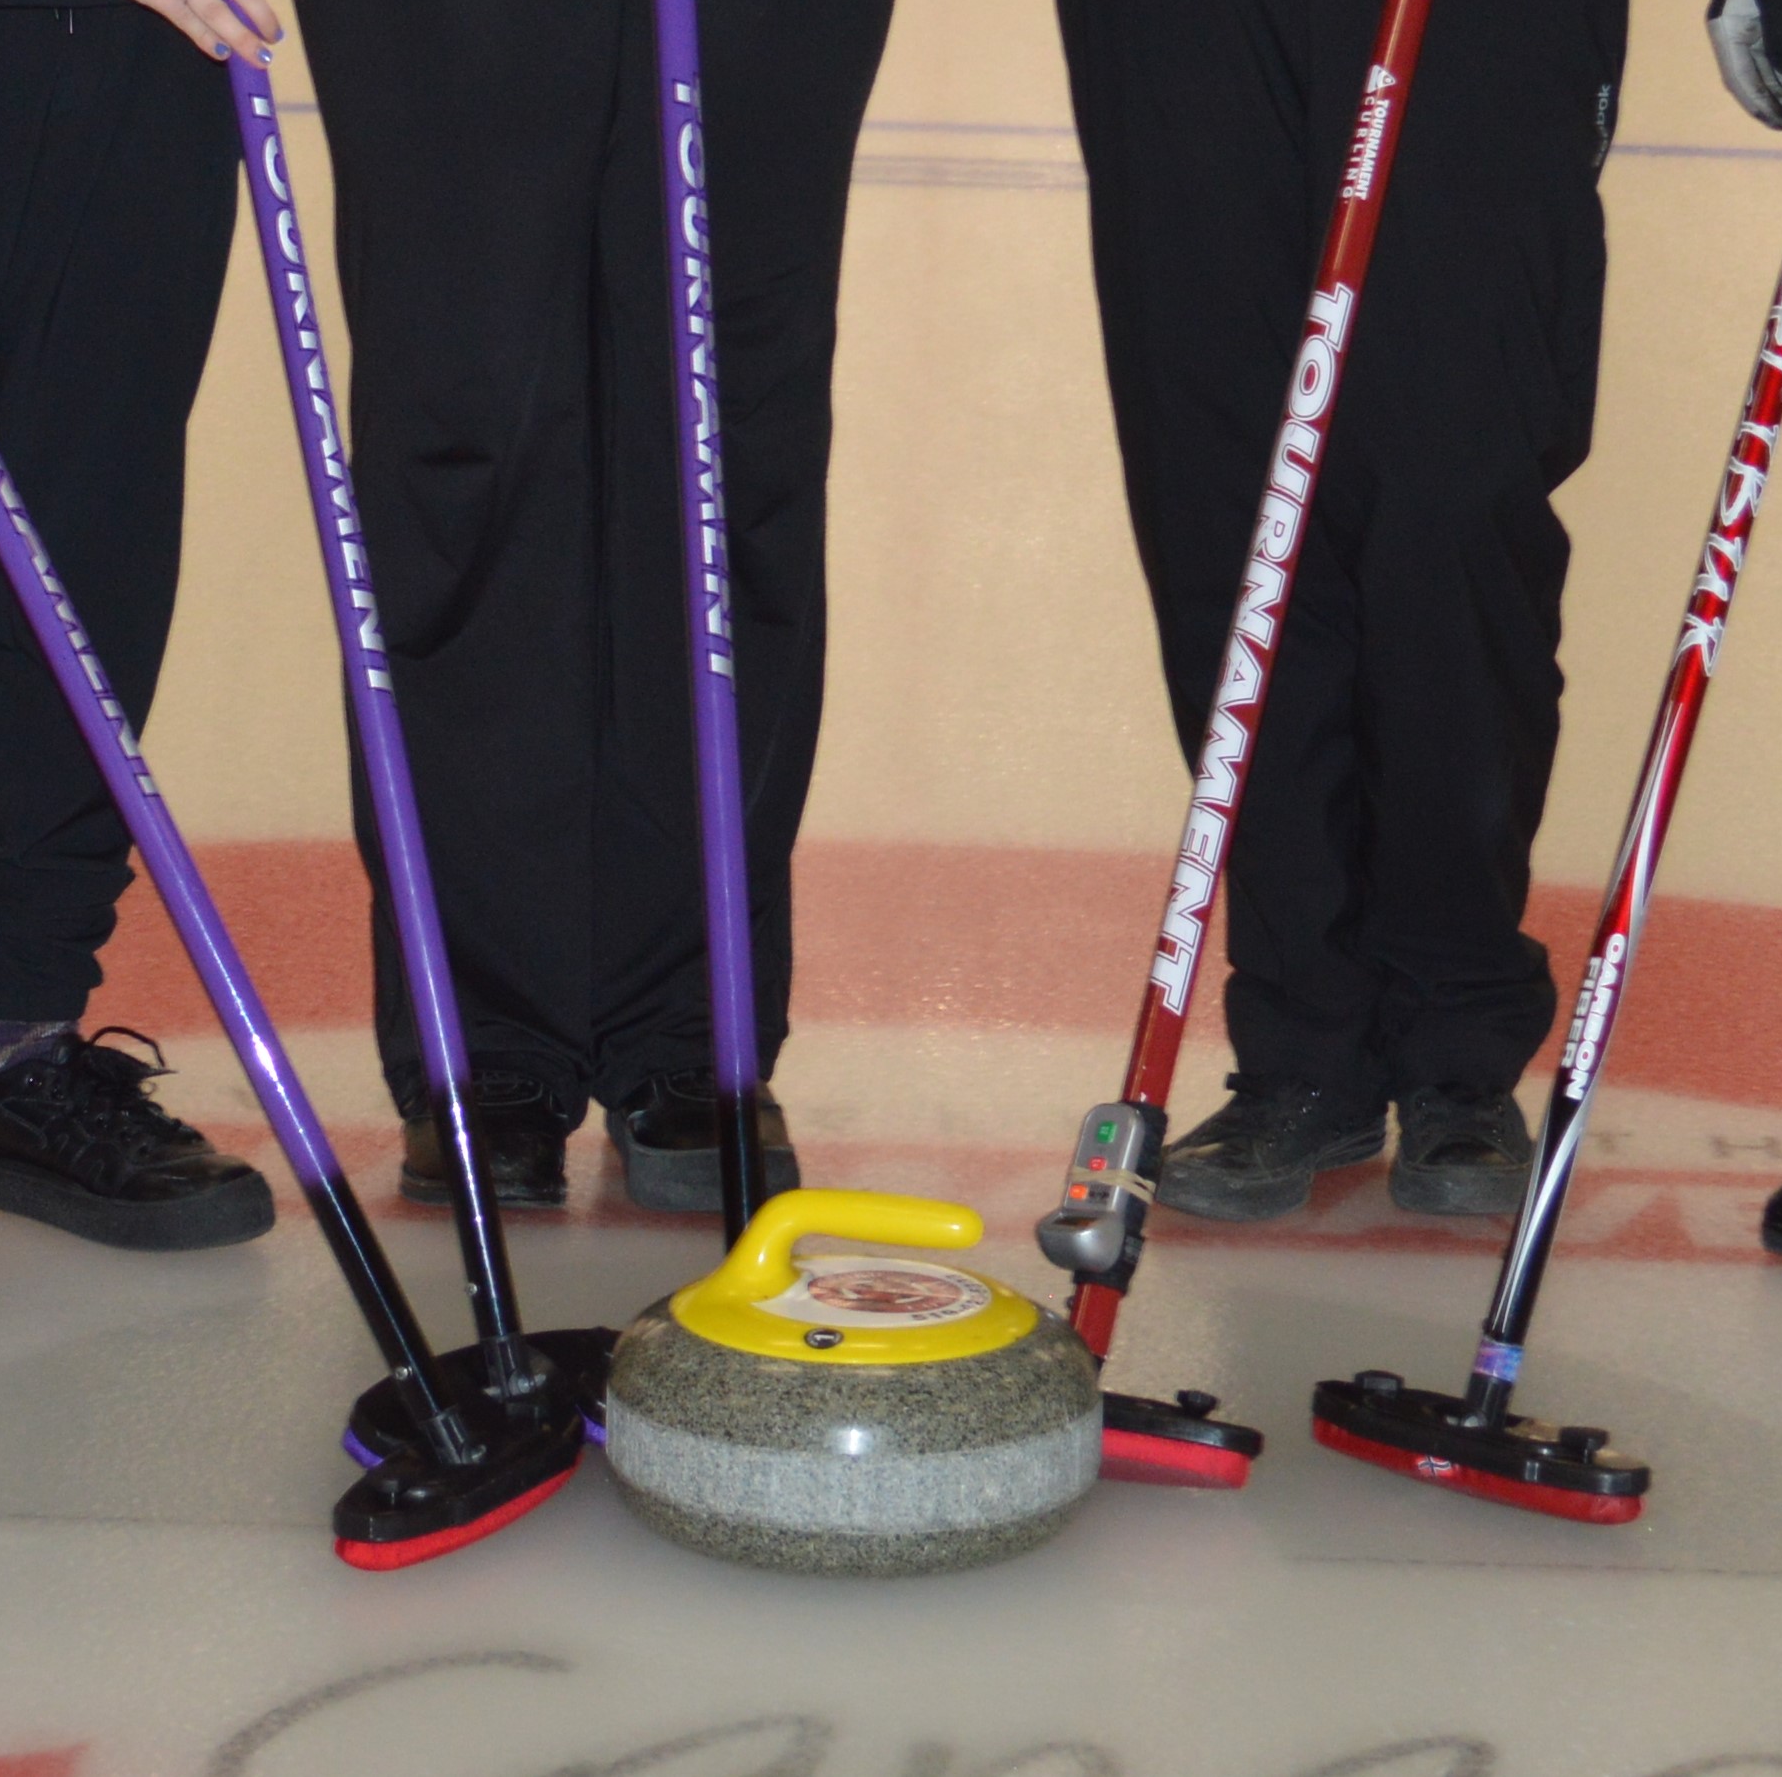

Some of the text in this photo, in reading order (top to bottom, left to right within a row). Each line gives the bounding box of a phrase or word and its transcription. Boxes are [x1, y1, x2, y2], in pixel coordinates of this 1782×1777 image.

[1342, 95, 1376, 199] CURLING
[1355, 98, 1390, 201] TOURNAMENT
[1148, 282, 1356, 1017] TOURNAMENT
[1560, 955, 1602, 1068] FIBER
[1564, 932, 1627, 1102] CARBON
